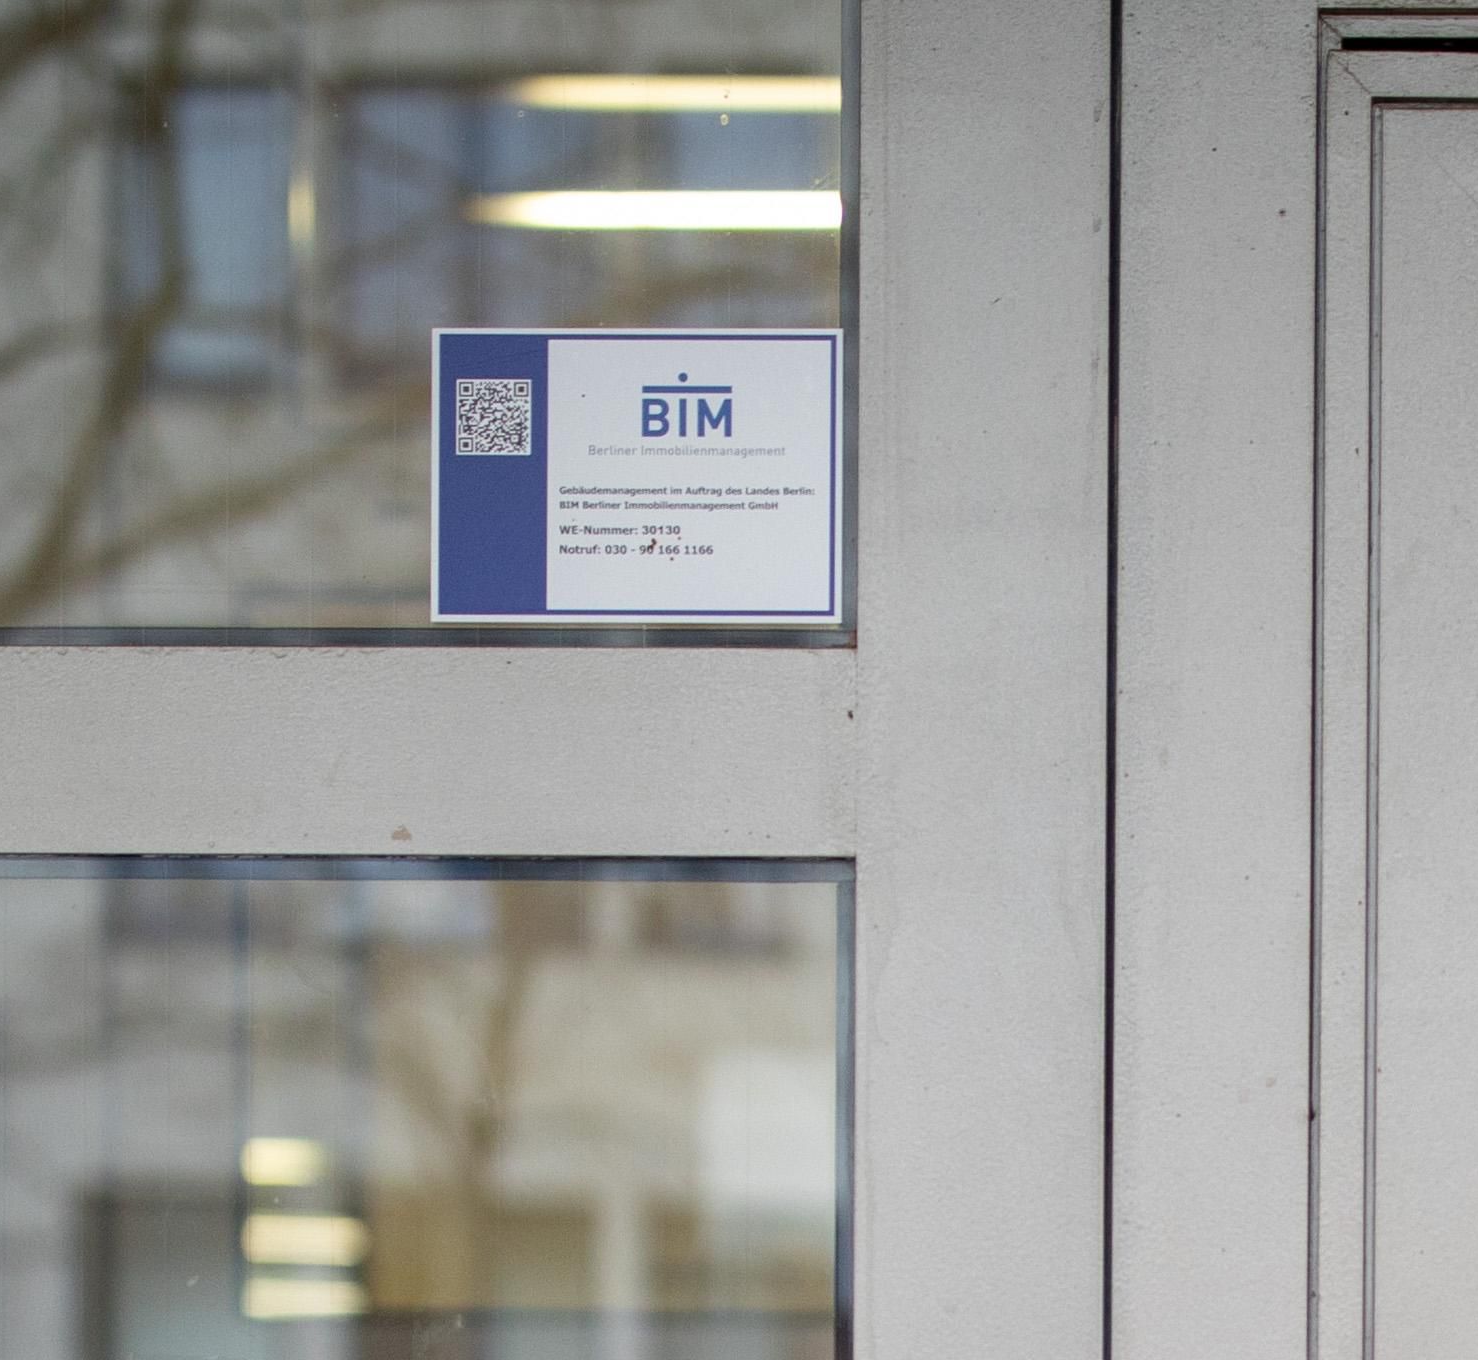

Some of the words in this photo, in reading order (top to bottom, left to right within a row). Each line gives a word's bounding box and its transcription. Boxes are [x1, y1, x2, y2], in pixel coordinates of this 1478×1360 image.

[641, 398, 732, 437] BIM
[587, 445, 637, 457] Berliner
[641, 445, 786, 459] Immobilienmanagement
[559, 486, 667, 497] Gebäudemanagement
[670, 486, 682, 495] im
[685, 486, 722, 497] Auftrag
[725, 486, 742, 496] des
[745, 487, 780, 496] Landes
[783, 487, 815, 496] Berlin:
[559, 501, 579, 510] BIM
[582, 501, 621, 510] Berliner
[624, 501, 745, 512] Immobilienmanagement
[748, 502, 779, 510] GmbH
[559, 525, 639, 535] WE-Nummer:
[642, 525, 681, 535] 30130
[559, 544, 601, 554] Notruf:
[605, 545, 627, 555] 030
[658, 545, 681, 555] 166
[684, 545, 714, 555] 1166
